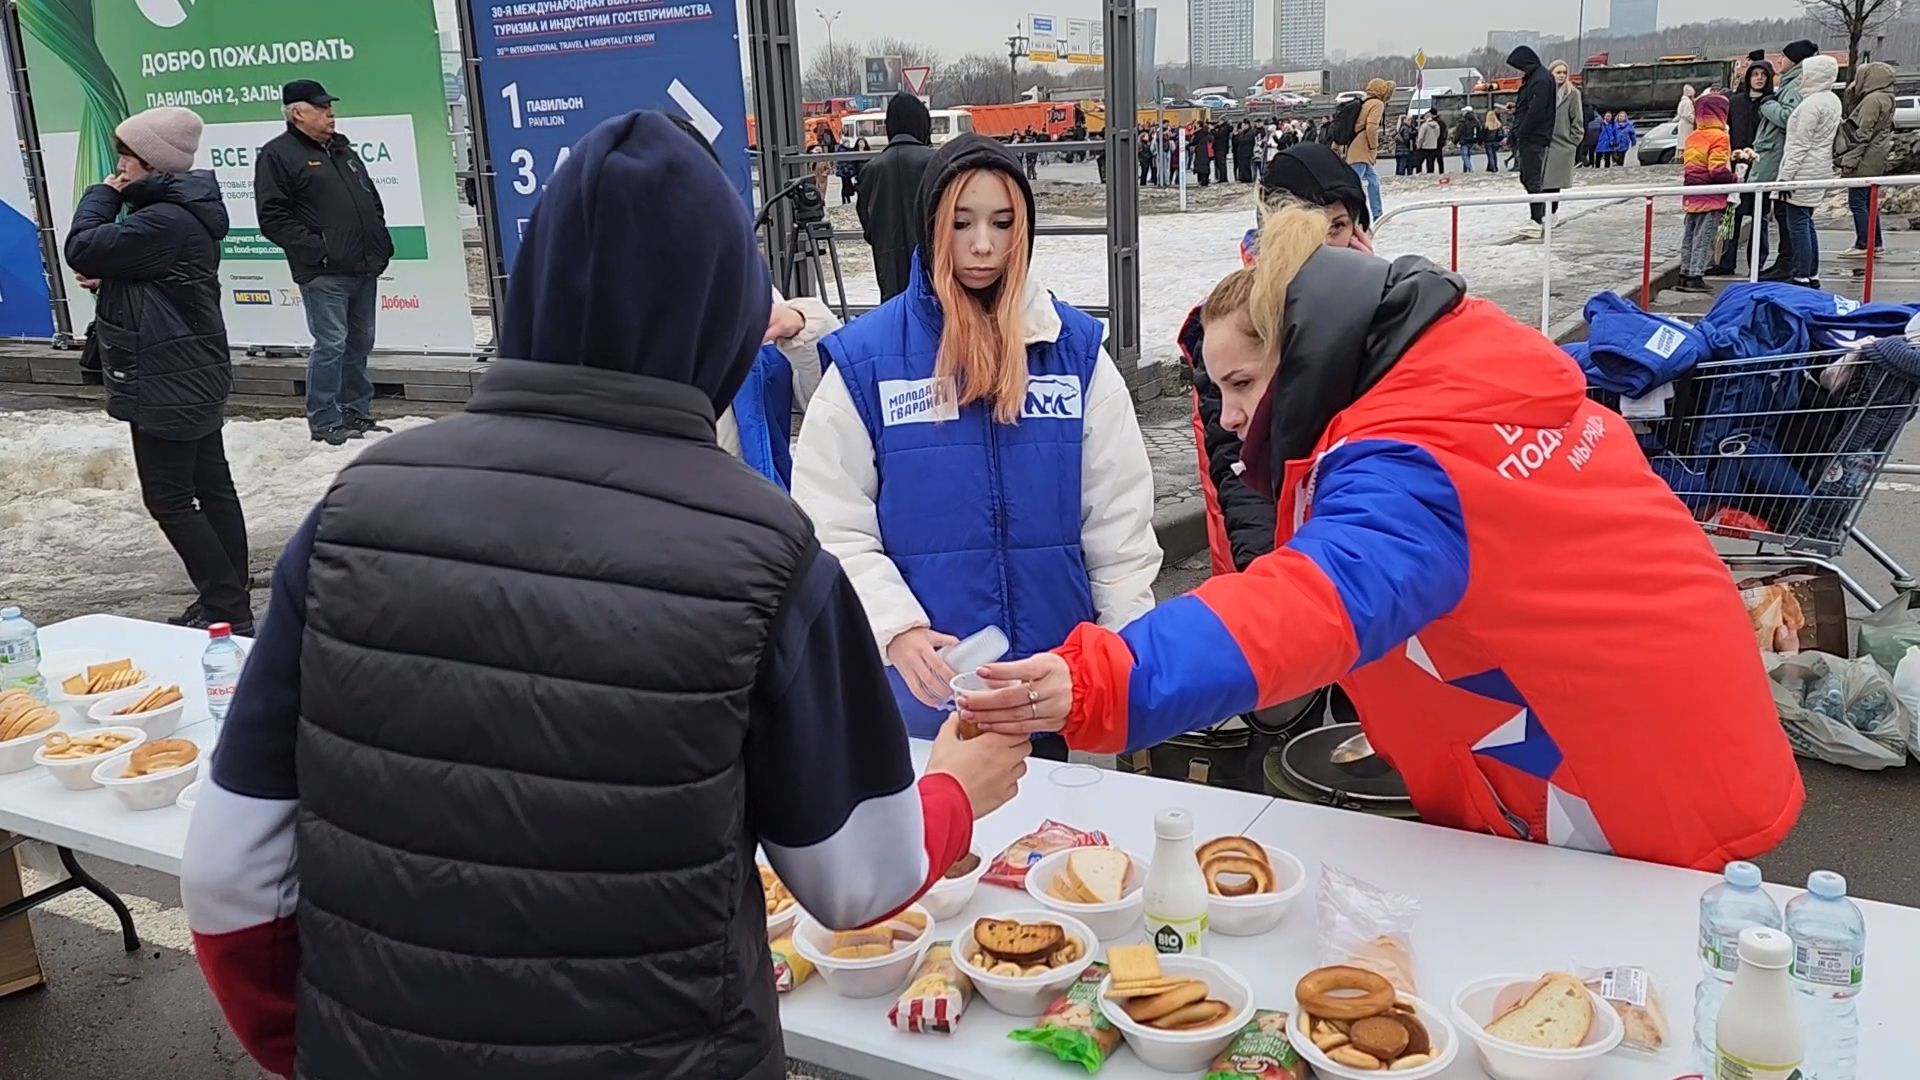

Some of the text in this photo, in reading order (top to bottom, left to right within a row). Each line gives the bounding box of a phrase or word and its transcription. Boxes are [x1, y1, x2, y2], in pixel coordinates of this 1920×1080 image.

[491, 7, 512, 18] 30-Я
[494, 3, 712, 36] ТУРИЗМА И ИНДУСТРИИ ГОСТЕПРИИМСТВА
[559, 40, 584, 50] TRAVEL
[590, 35, 633, 47] HOSPITALITY
[634, 33, 655, 43] SHOW
[141, 38, 354, 77] ДОБРО ПОЖАЛОВАТЬ
[146, 84, 284, 107] ПАВИЛЬОН 2, ЗАЛЫ
[501, 81, 521, 128] 1
[526, 97, 584, 113] ПАВИЛЬОН
[528, 115, 566, 127] PAVILION
[211, 147, 249, 167] ВСЕ
[234, 291, 270, 303] METRO
[381, 294, 420, 310] Добрый
[1567, 440, 1592, 472] МЫ
[1158, 932, 1179, 947] BIO
